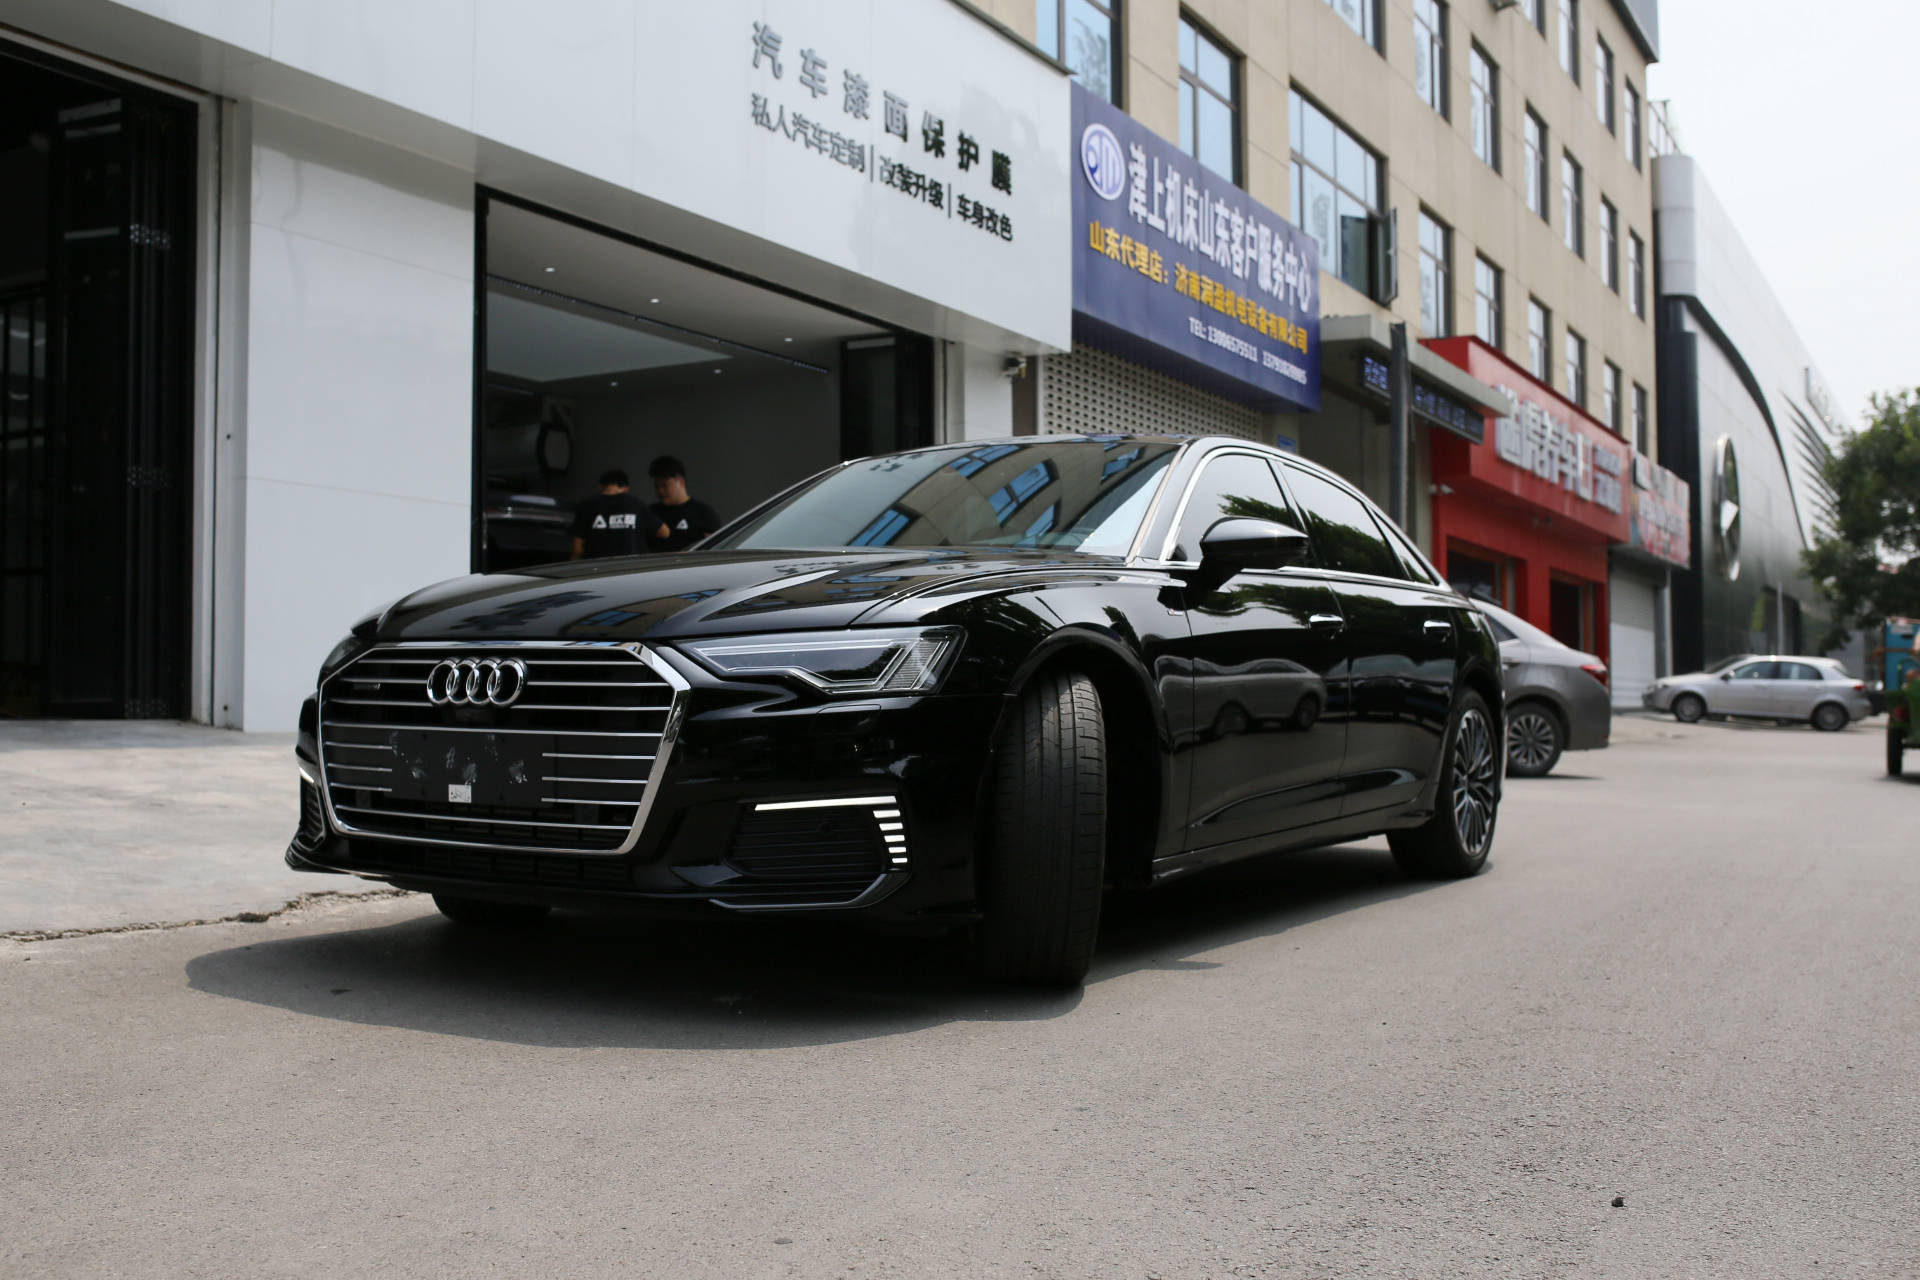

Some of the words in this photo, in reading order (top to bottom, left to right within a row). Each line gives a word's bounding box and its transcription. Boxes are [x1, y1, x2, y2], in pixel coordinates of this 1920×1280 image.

[751, 20, 1013, 196] 汽车漆面保护膜
